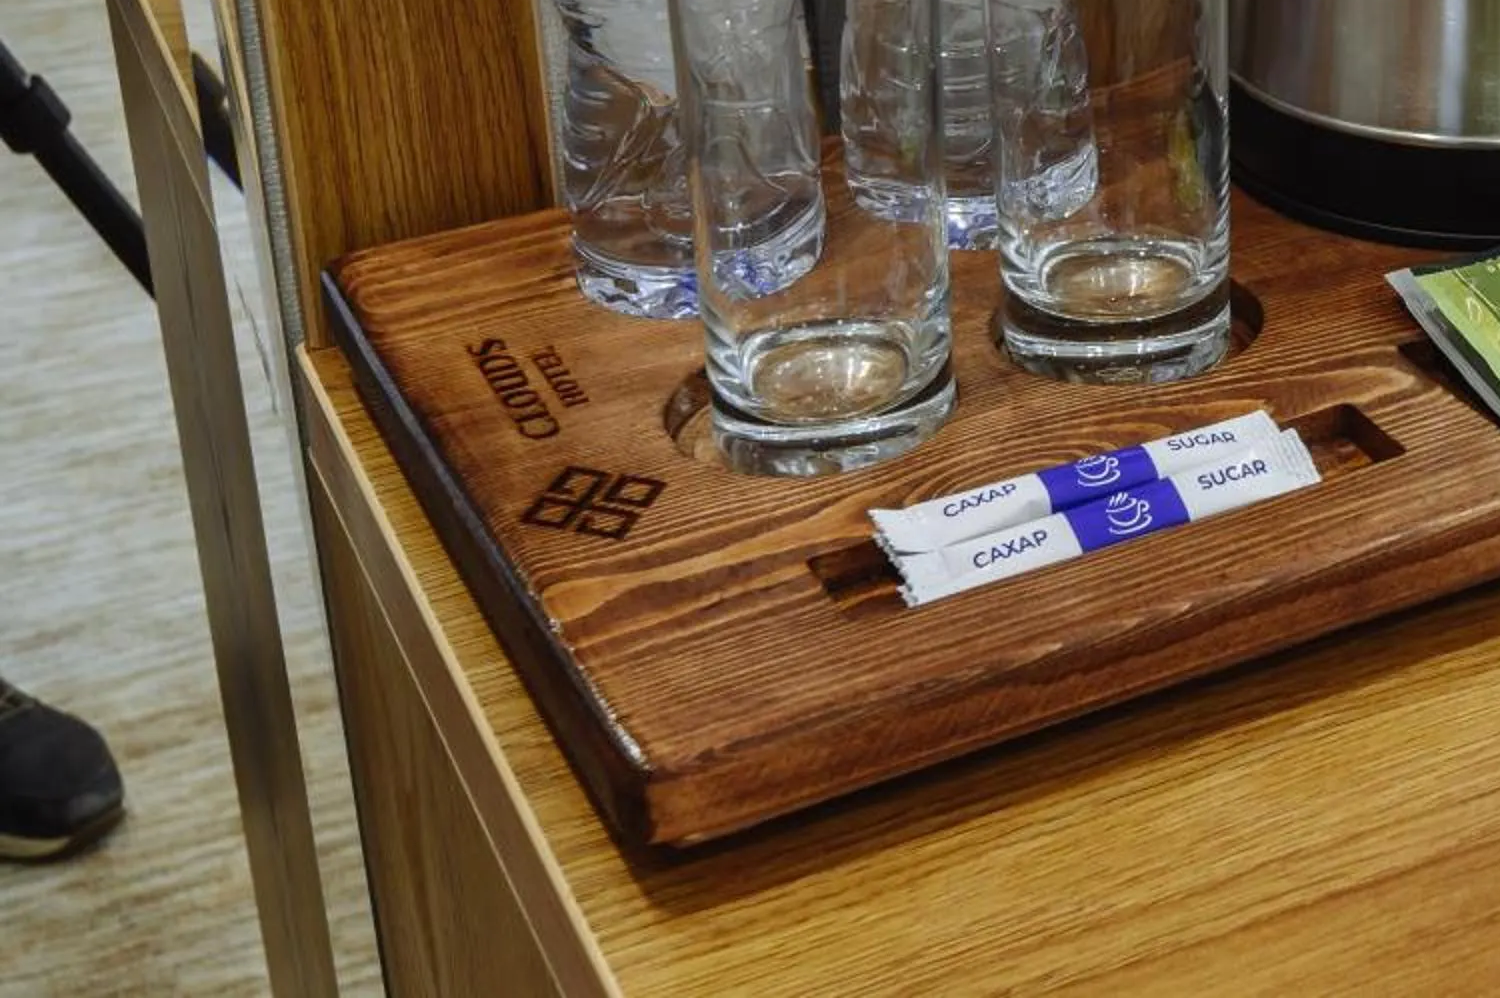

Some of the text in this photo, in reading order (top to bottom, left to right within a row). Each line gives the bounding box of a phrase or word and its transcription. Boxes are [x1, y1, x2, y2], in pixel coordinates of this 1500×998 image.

[465, 337, 560, 440] CLOUDS
[532, 345, 590, 408] HOTEL
[1167, 431, 1237, 451] SUGAR
[973, 529, 1048, 569] САХАР
